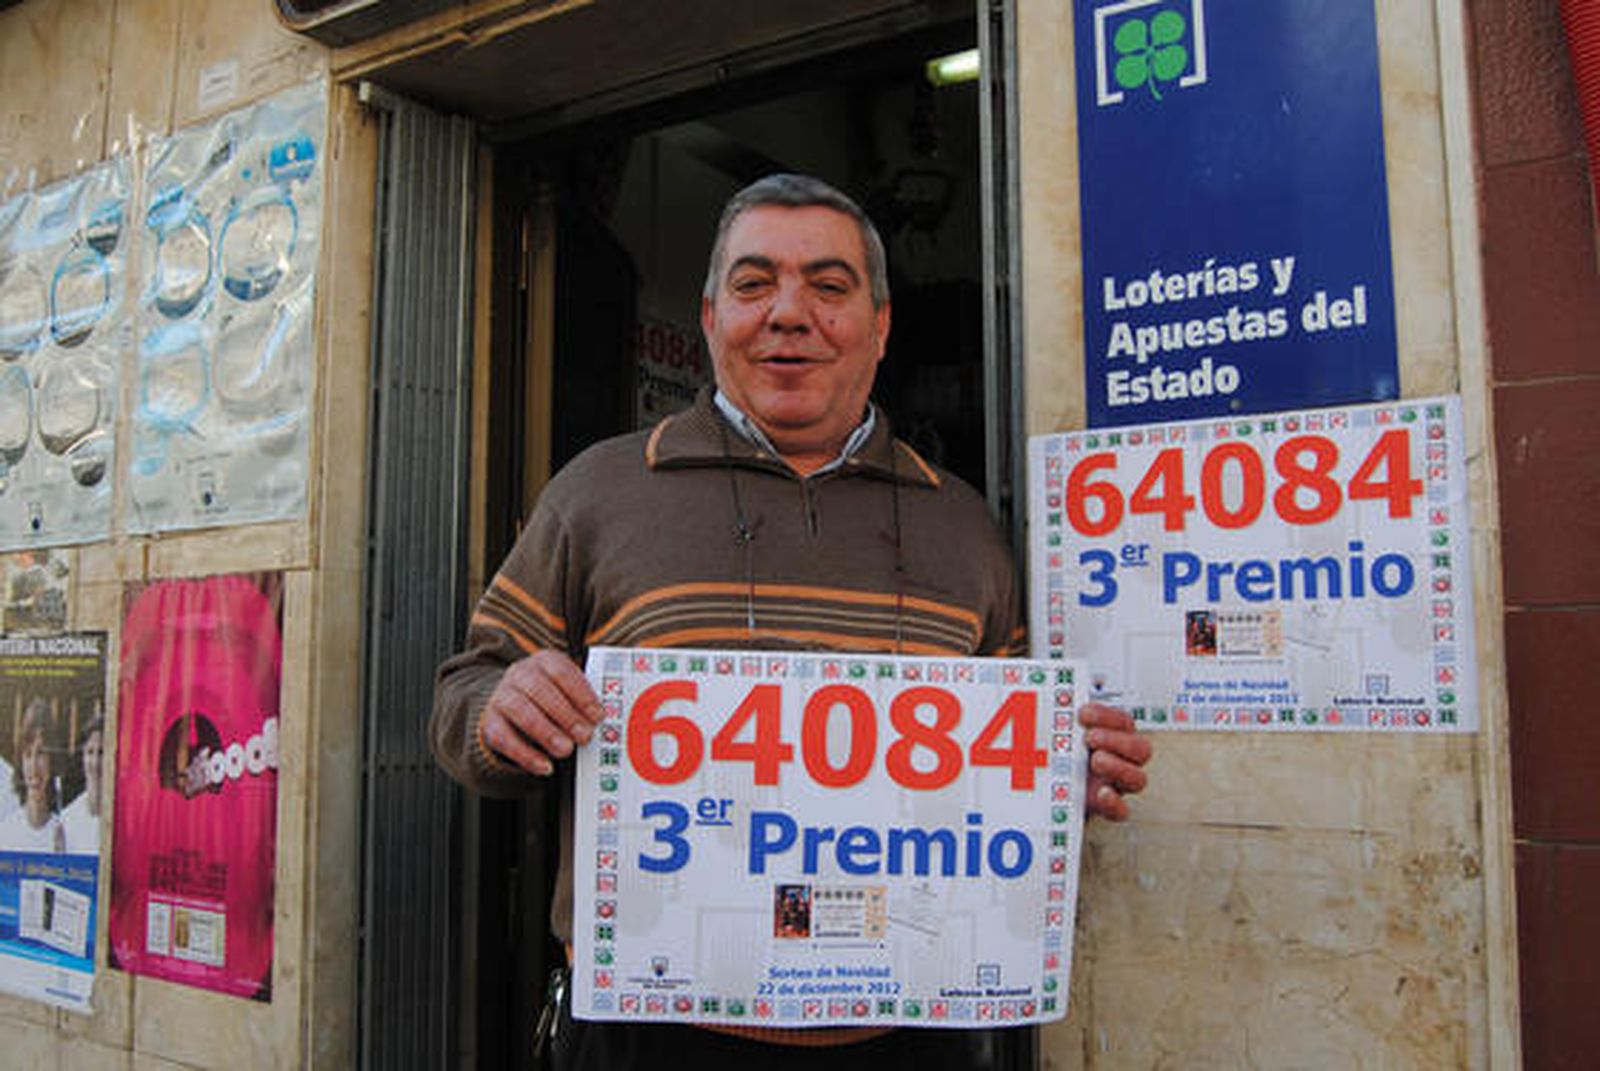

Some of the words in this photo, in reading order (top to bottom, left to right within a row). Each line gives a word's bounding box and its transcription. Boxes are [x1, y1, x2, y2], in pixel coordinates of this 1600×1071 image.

[1103, 258, 1260, 312] Loterías
[1271, 256, 1296, 296] y
[1106, 305, 1289, 364] Apuestas
[1301, 285, 1368, 333] del
[1106, 357, 1241, 407] Estado
[1065, 428, 1424, 538] 64084
[1162, 540, 1416, 605] Premio
[626, 679, 1049, 792] 64084
[748, 811, 1034, 879] Premio
